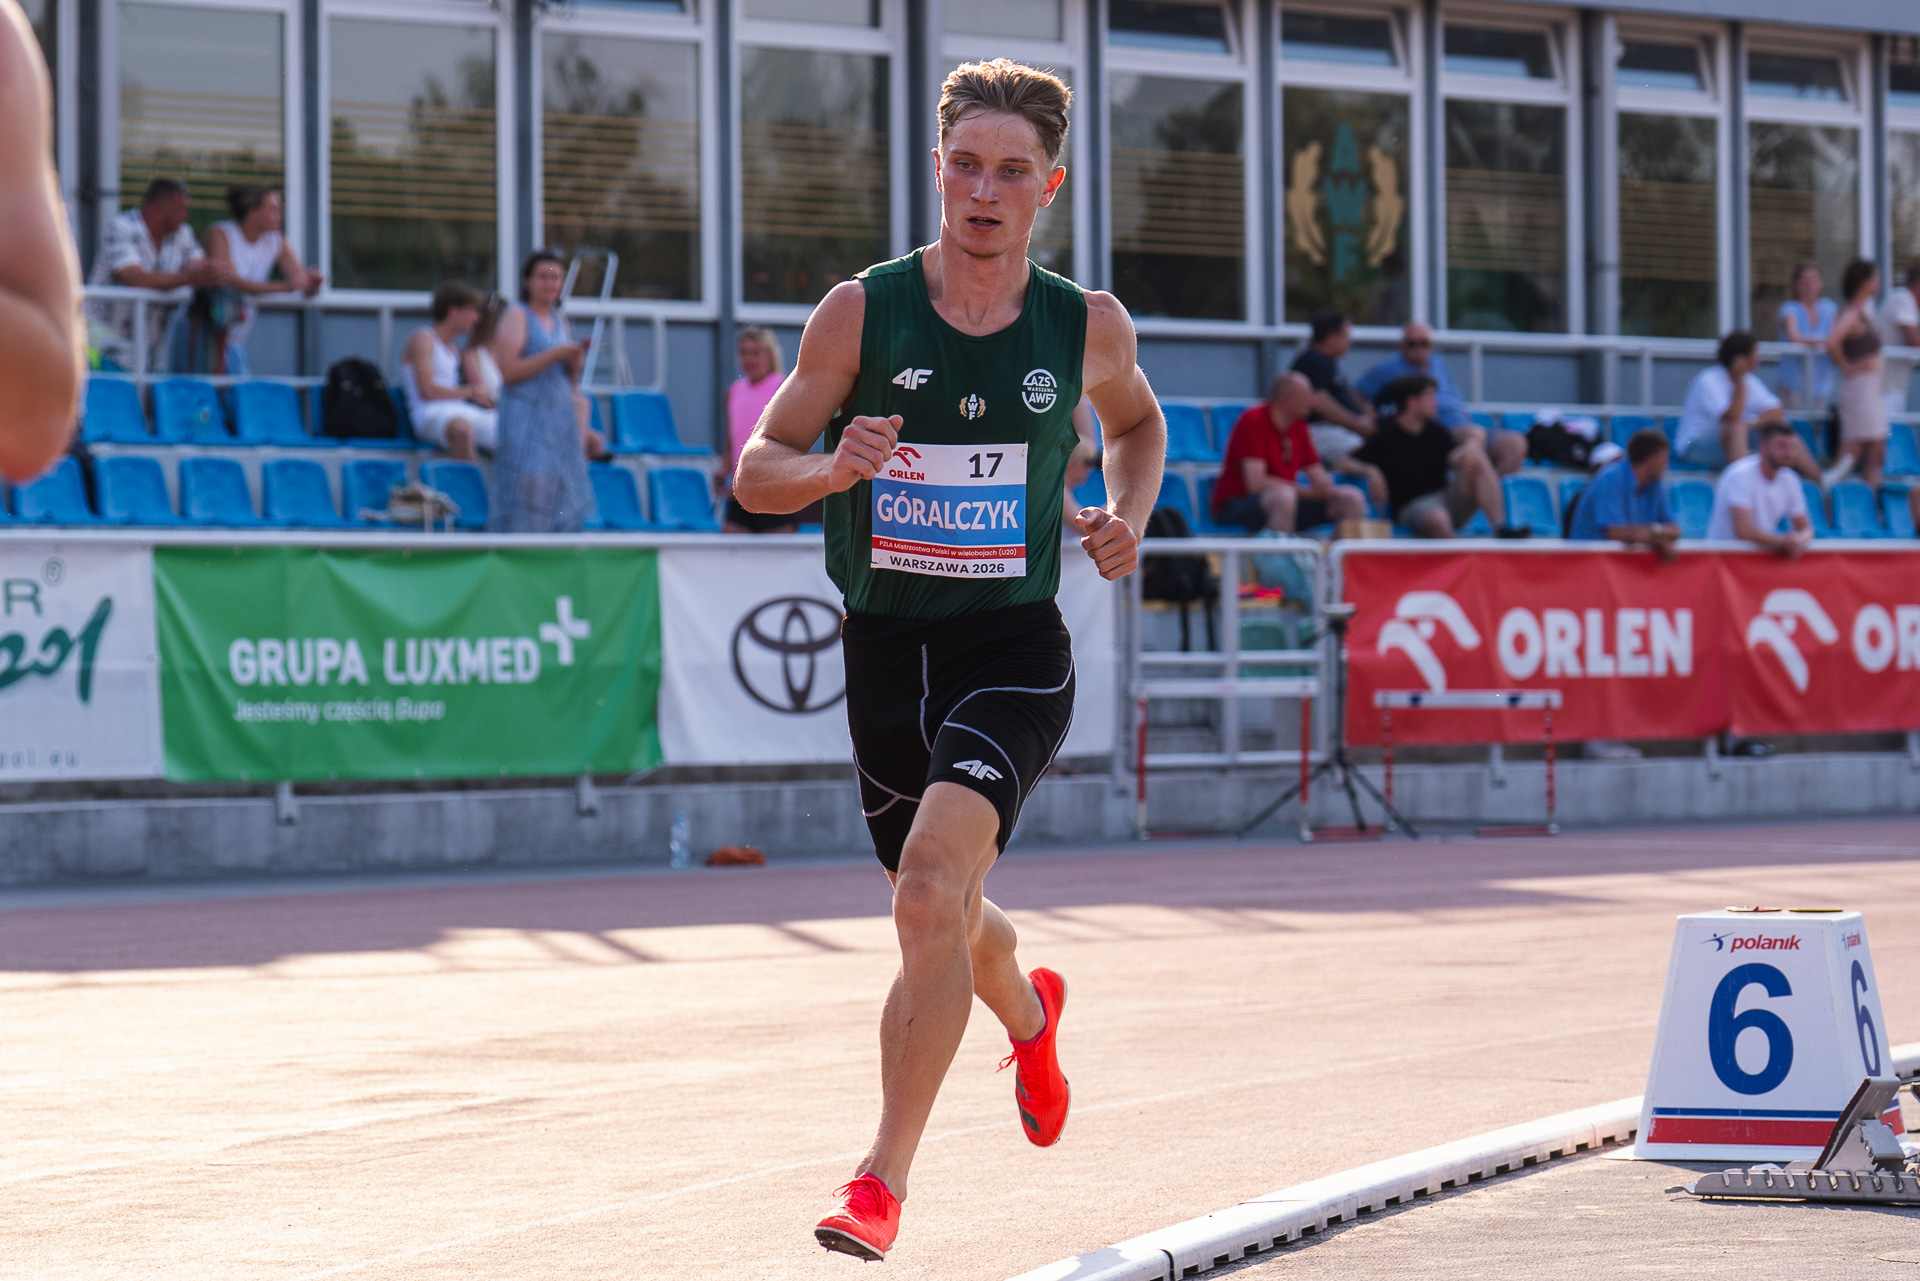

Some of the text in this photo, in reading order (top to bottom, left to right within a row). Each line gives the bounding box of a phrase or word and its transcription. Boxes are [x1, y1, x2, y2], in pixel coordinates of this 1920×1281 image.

[892, 368, 933, 390] 4F
[1031, 375, 1051, 387] AZS
[1028, 392, 1052, 404] AWF
[889, 469, 925, 481] ORLEN
[968, 452, 1004, 478] 17
[876, 490, 1019, 531] GÓRALCZYK
[879, 540, 893, 548] PZLA
[894, 542, 931, 553] Mistrzostwa
[931, 547, 950, 556] Polski
[957, 549, 997, 558] wielobojach
[998, 548, 1017, 557] (U20)
[889, 555, 1005, 574] WARSZAWA 2026
[1497, 607, 1693, 681] ORLEN
[229, 637, 542, 686] GRUPA LUXMED
[952, 759, 1004, 781] 4F
[1730, 934, 1802, 953] polanik
[1708, 962, 1794, 1095] 6
[1851, 959, 1881, 1077] 6
